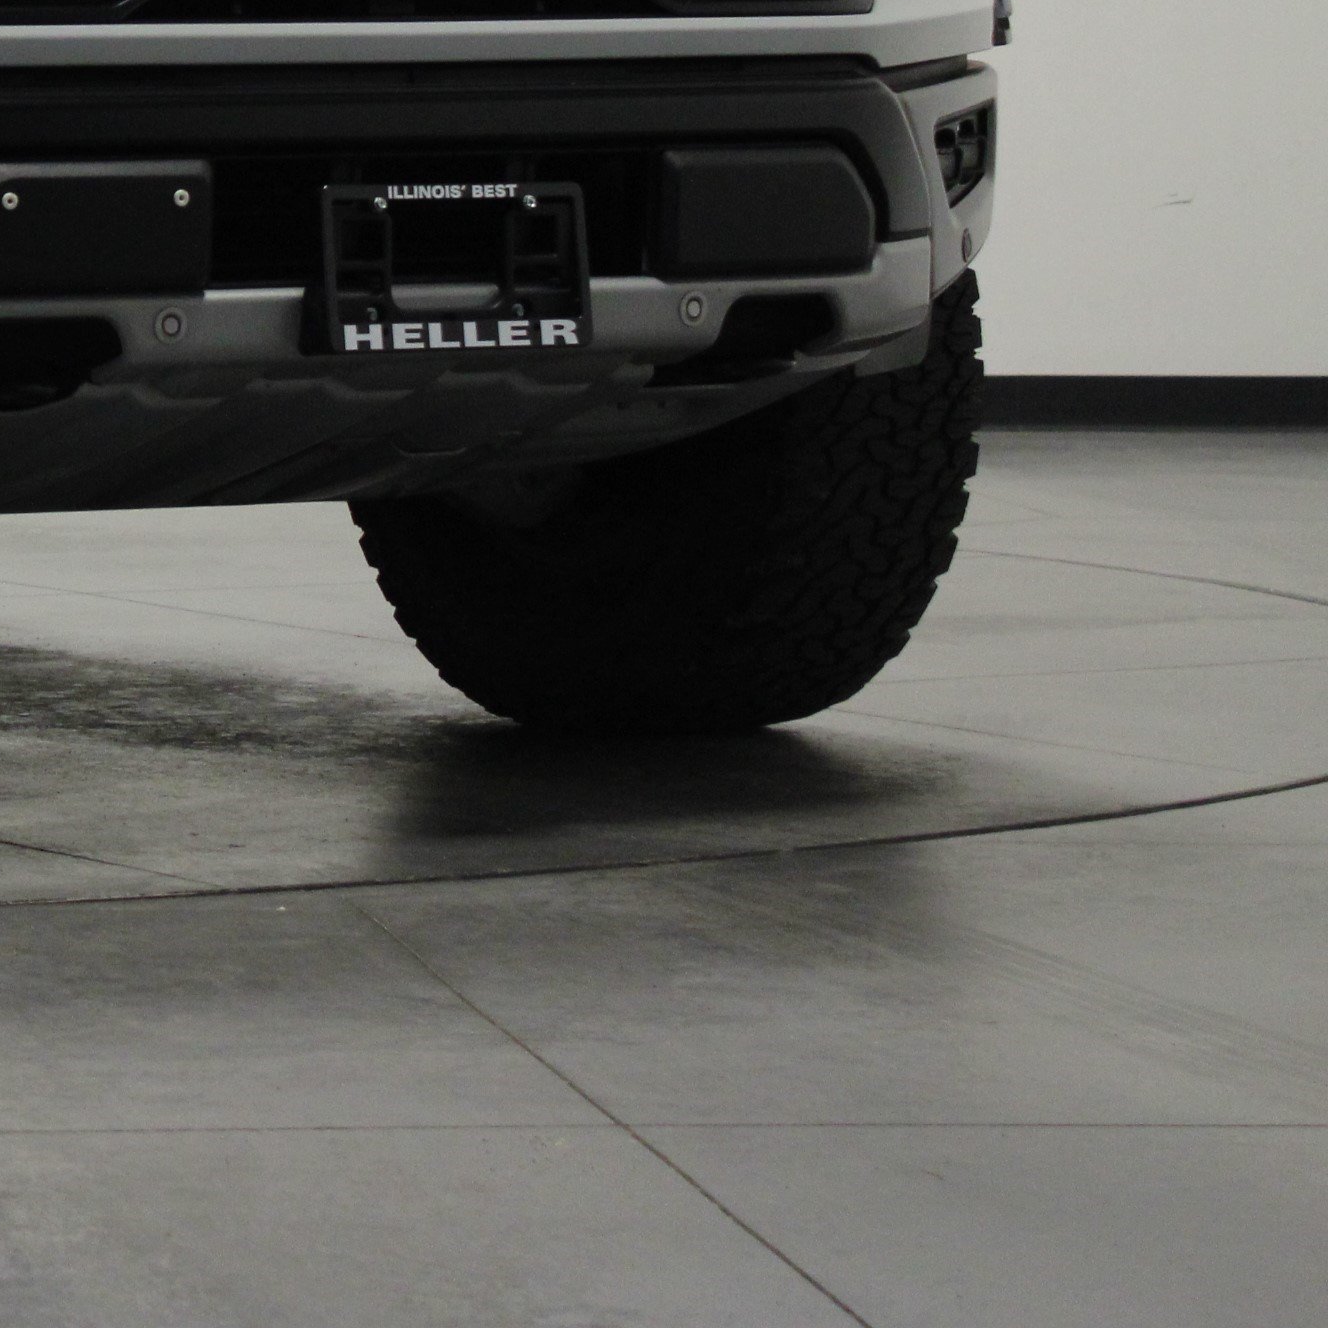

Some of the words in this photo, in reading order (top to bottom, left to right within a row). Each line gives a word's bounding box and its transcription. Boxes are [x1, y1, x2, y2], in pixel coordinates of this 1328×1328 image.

[387, 184, 466, 200] ILLINOIS'
[471, 183, 518, 198] BEST
[344, 318, 579, 351] HELLER
